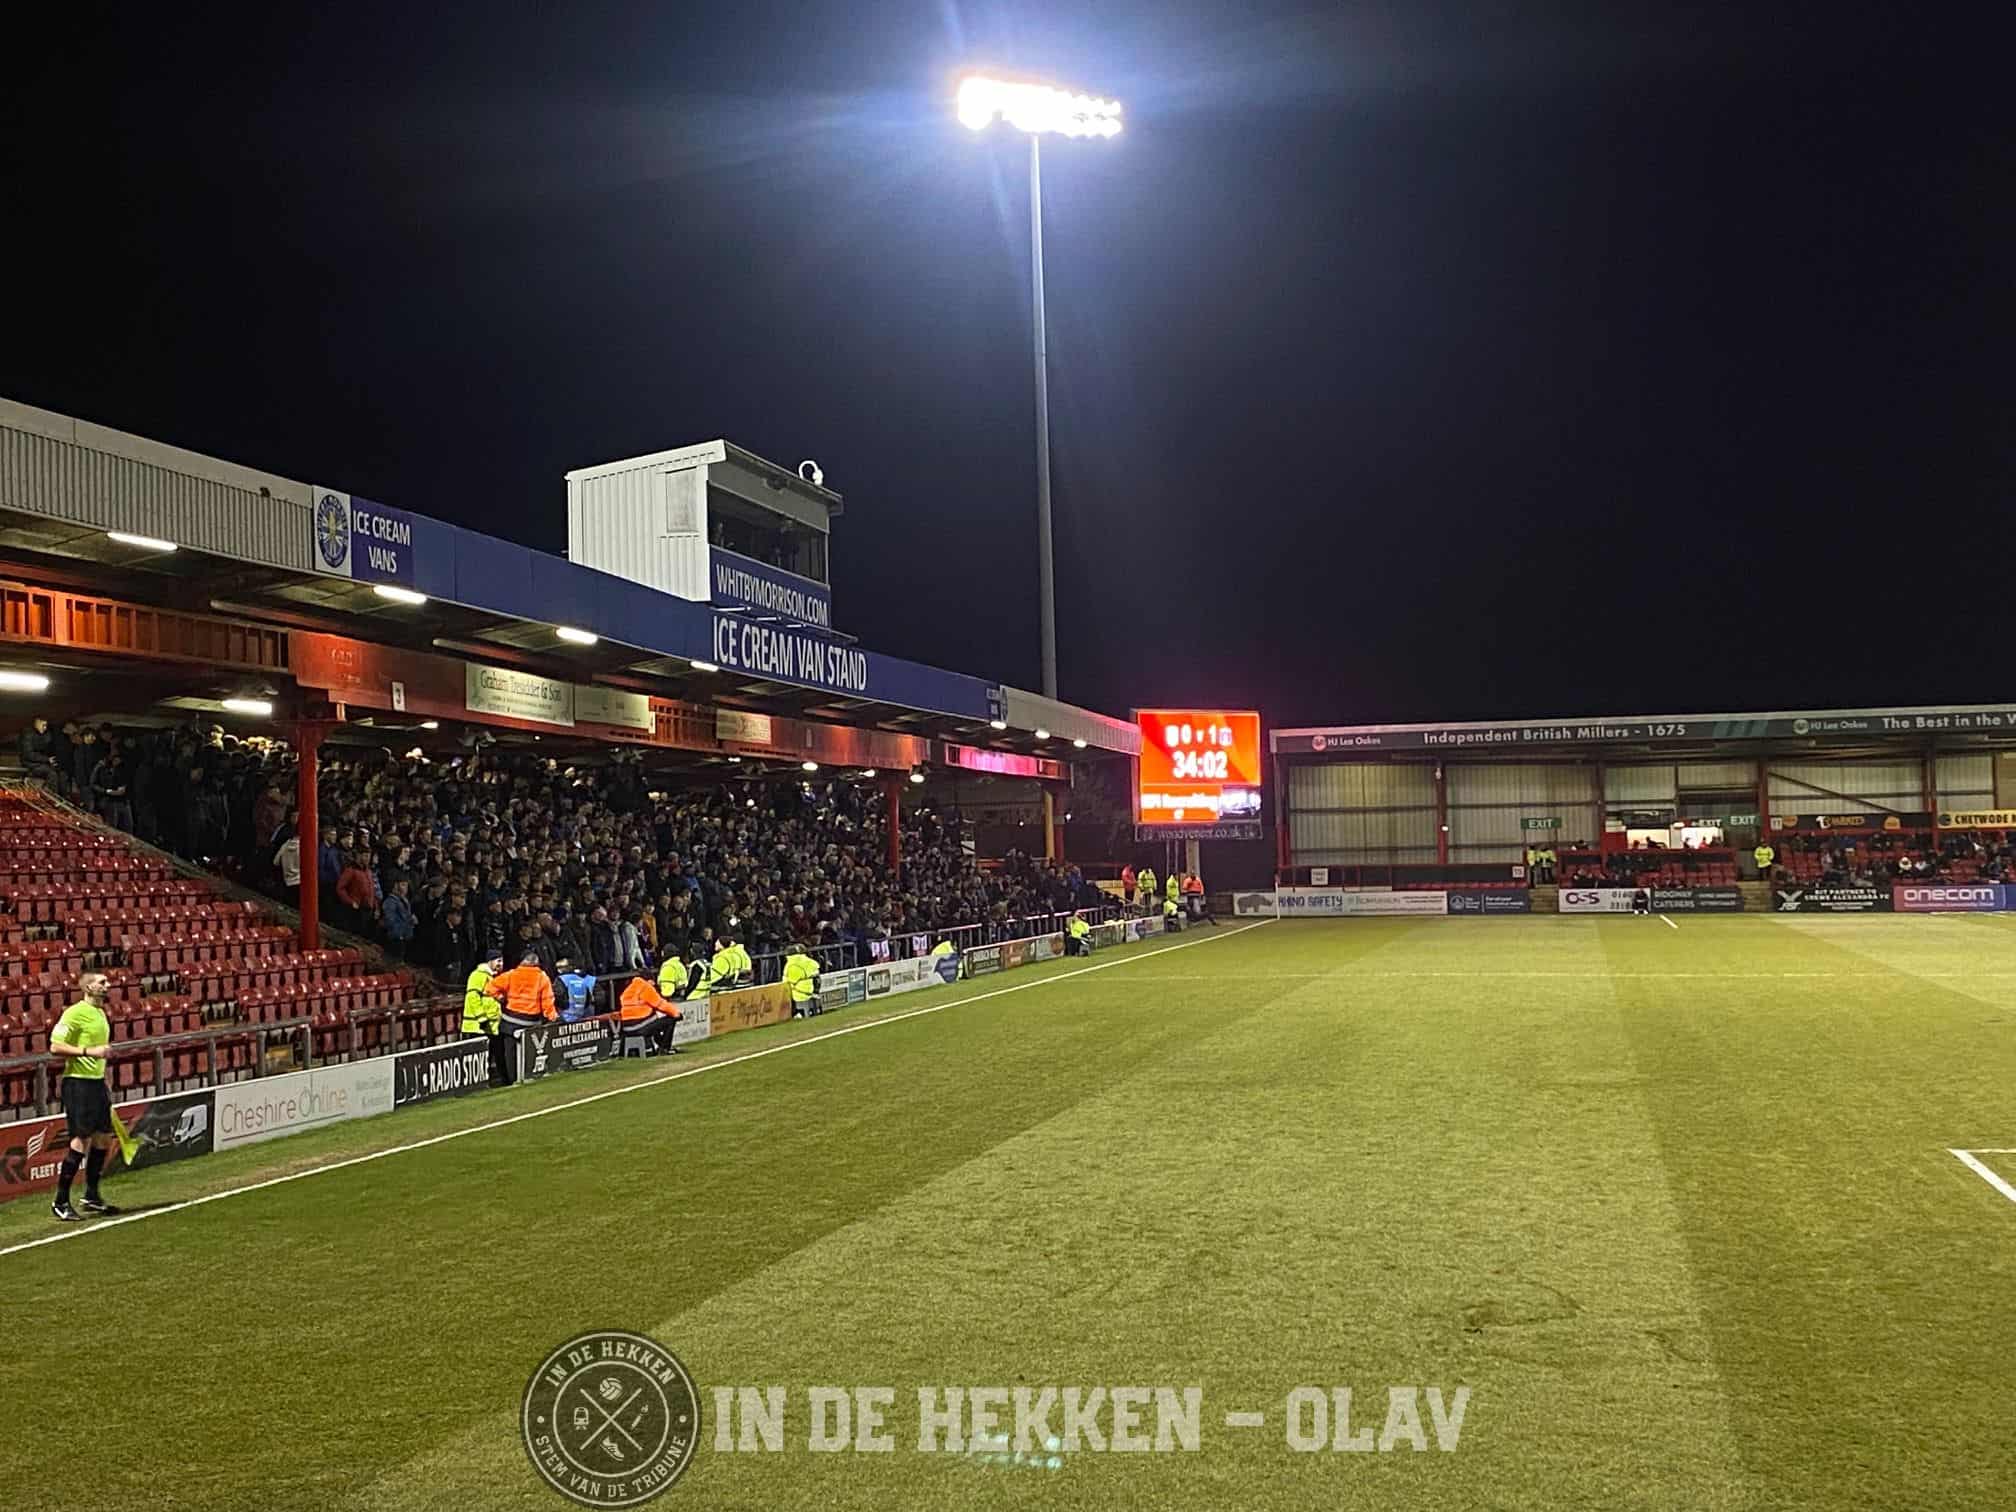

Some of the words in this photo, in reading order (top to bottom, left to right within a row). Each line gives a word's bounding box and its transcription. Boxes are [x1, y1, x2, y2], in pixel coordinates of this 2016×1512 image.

[352, 510, 370, 535] ICE
[372, 515, 411, 546] CREAM
[368, 545, 397, 573] VANS
[716, 563, 828, 627] WHITBYMORRISON.COM
[713, 615, 738, 665] ICE
[741, 623, 793, 677] CREAM
[797, 636, 825, 682] VAN
[827, 644, 867, 691] STAND
[1882, 717, 1909, 729] The
[1916, 715, 1949, 729] Best
[1955, 714, 1970, 727] in
[1976, 713, 2001, 726] the
[1424, 729, 1517, 745] Independent
[1523, 726, 1571, 741] British
[1577, 724, 1629, 739] Millers
[1647, 724, 1686, 736] 1675
[1172, 750, 1228, 779] 34:02
[1528, 818, 1553, 829] EXIT
[1730, 815, 1756, 826] EXIT
[1955, 812, 2009, 825] CHETWODE
[1903, 888, 1994, 901] onecom
[568, 1021, 593, 1035] PARTNER
[429, 1058, 461, 1094] RADIO
[463, 1050, 489, 1089] STOKE
[221, 1096, 297, 1133] Cheshire
[30, 1164, 55, 1181] FLEET
